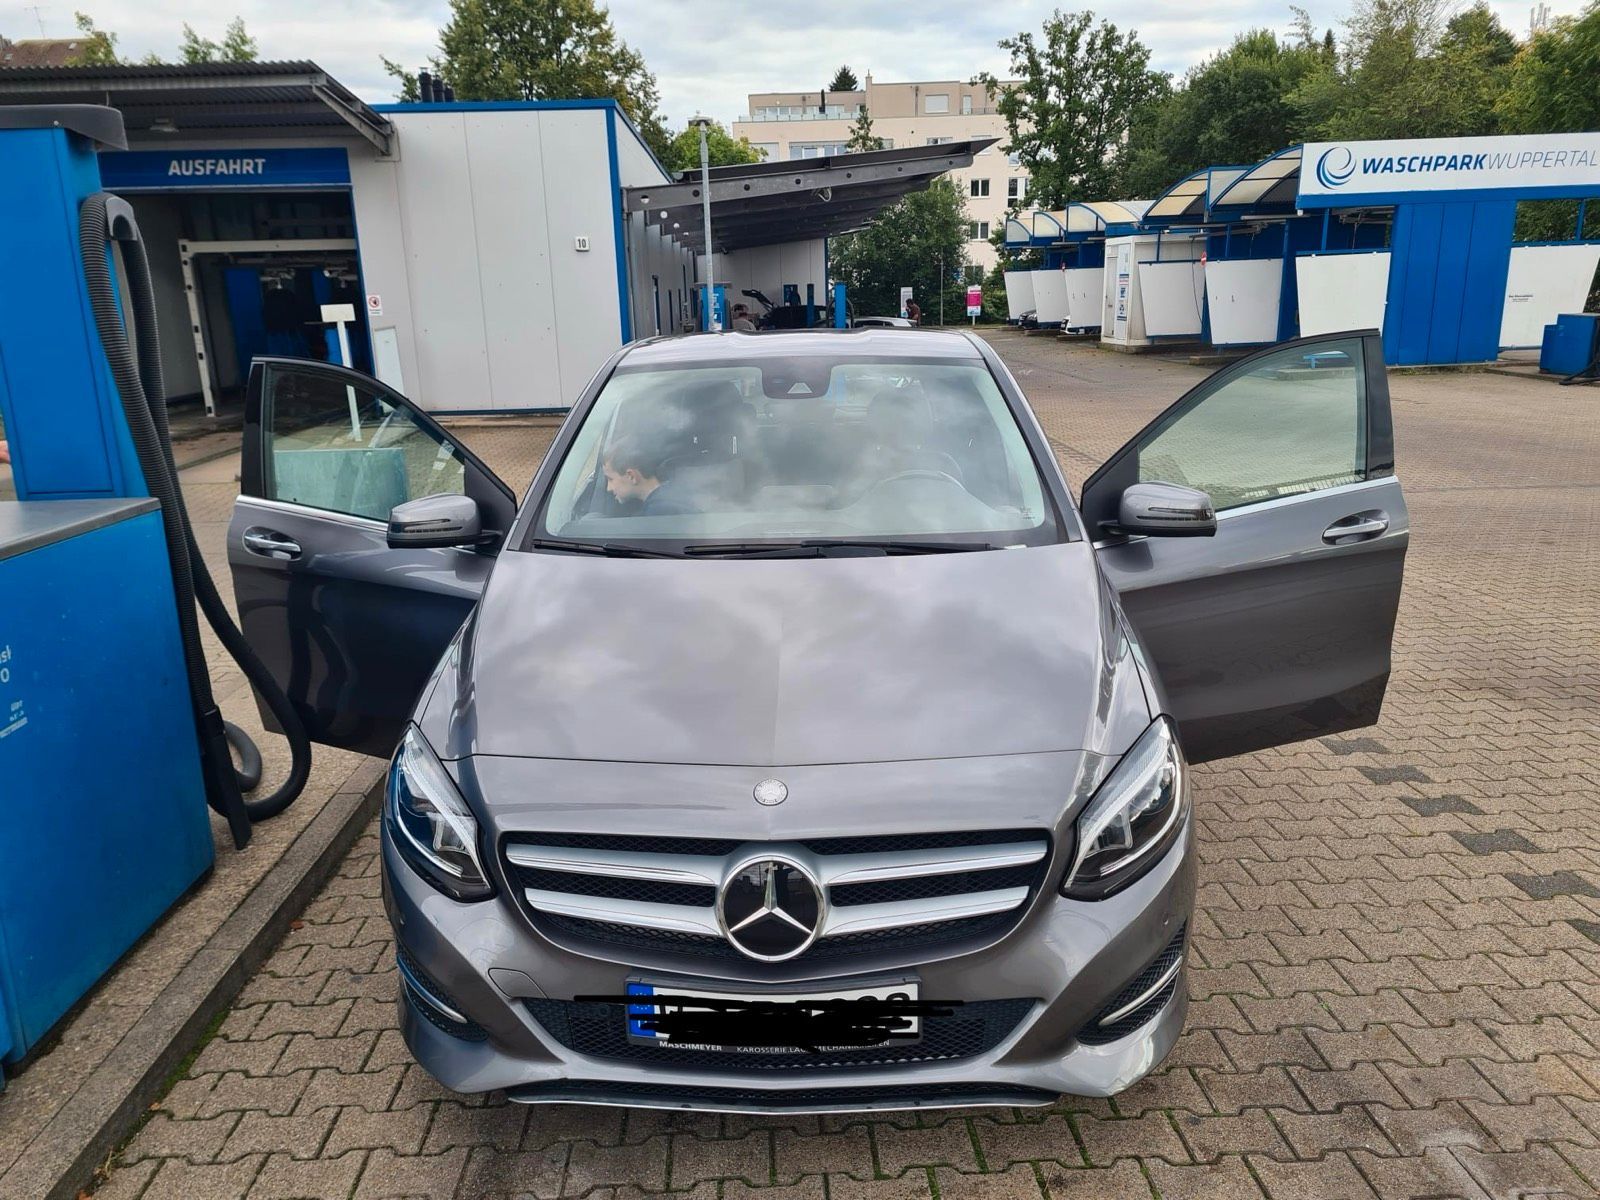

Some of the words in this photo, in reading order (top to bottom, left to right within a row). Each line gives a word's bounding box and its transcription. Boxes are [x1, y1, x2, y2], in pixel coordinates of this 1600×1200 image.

[168, 158, 266, 176] AUSFAHRT
[577, 238, 587, 249] 10
[659, 1040, 722, 1052] MASCHMEYER
